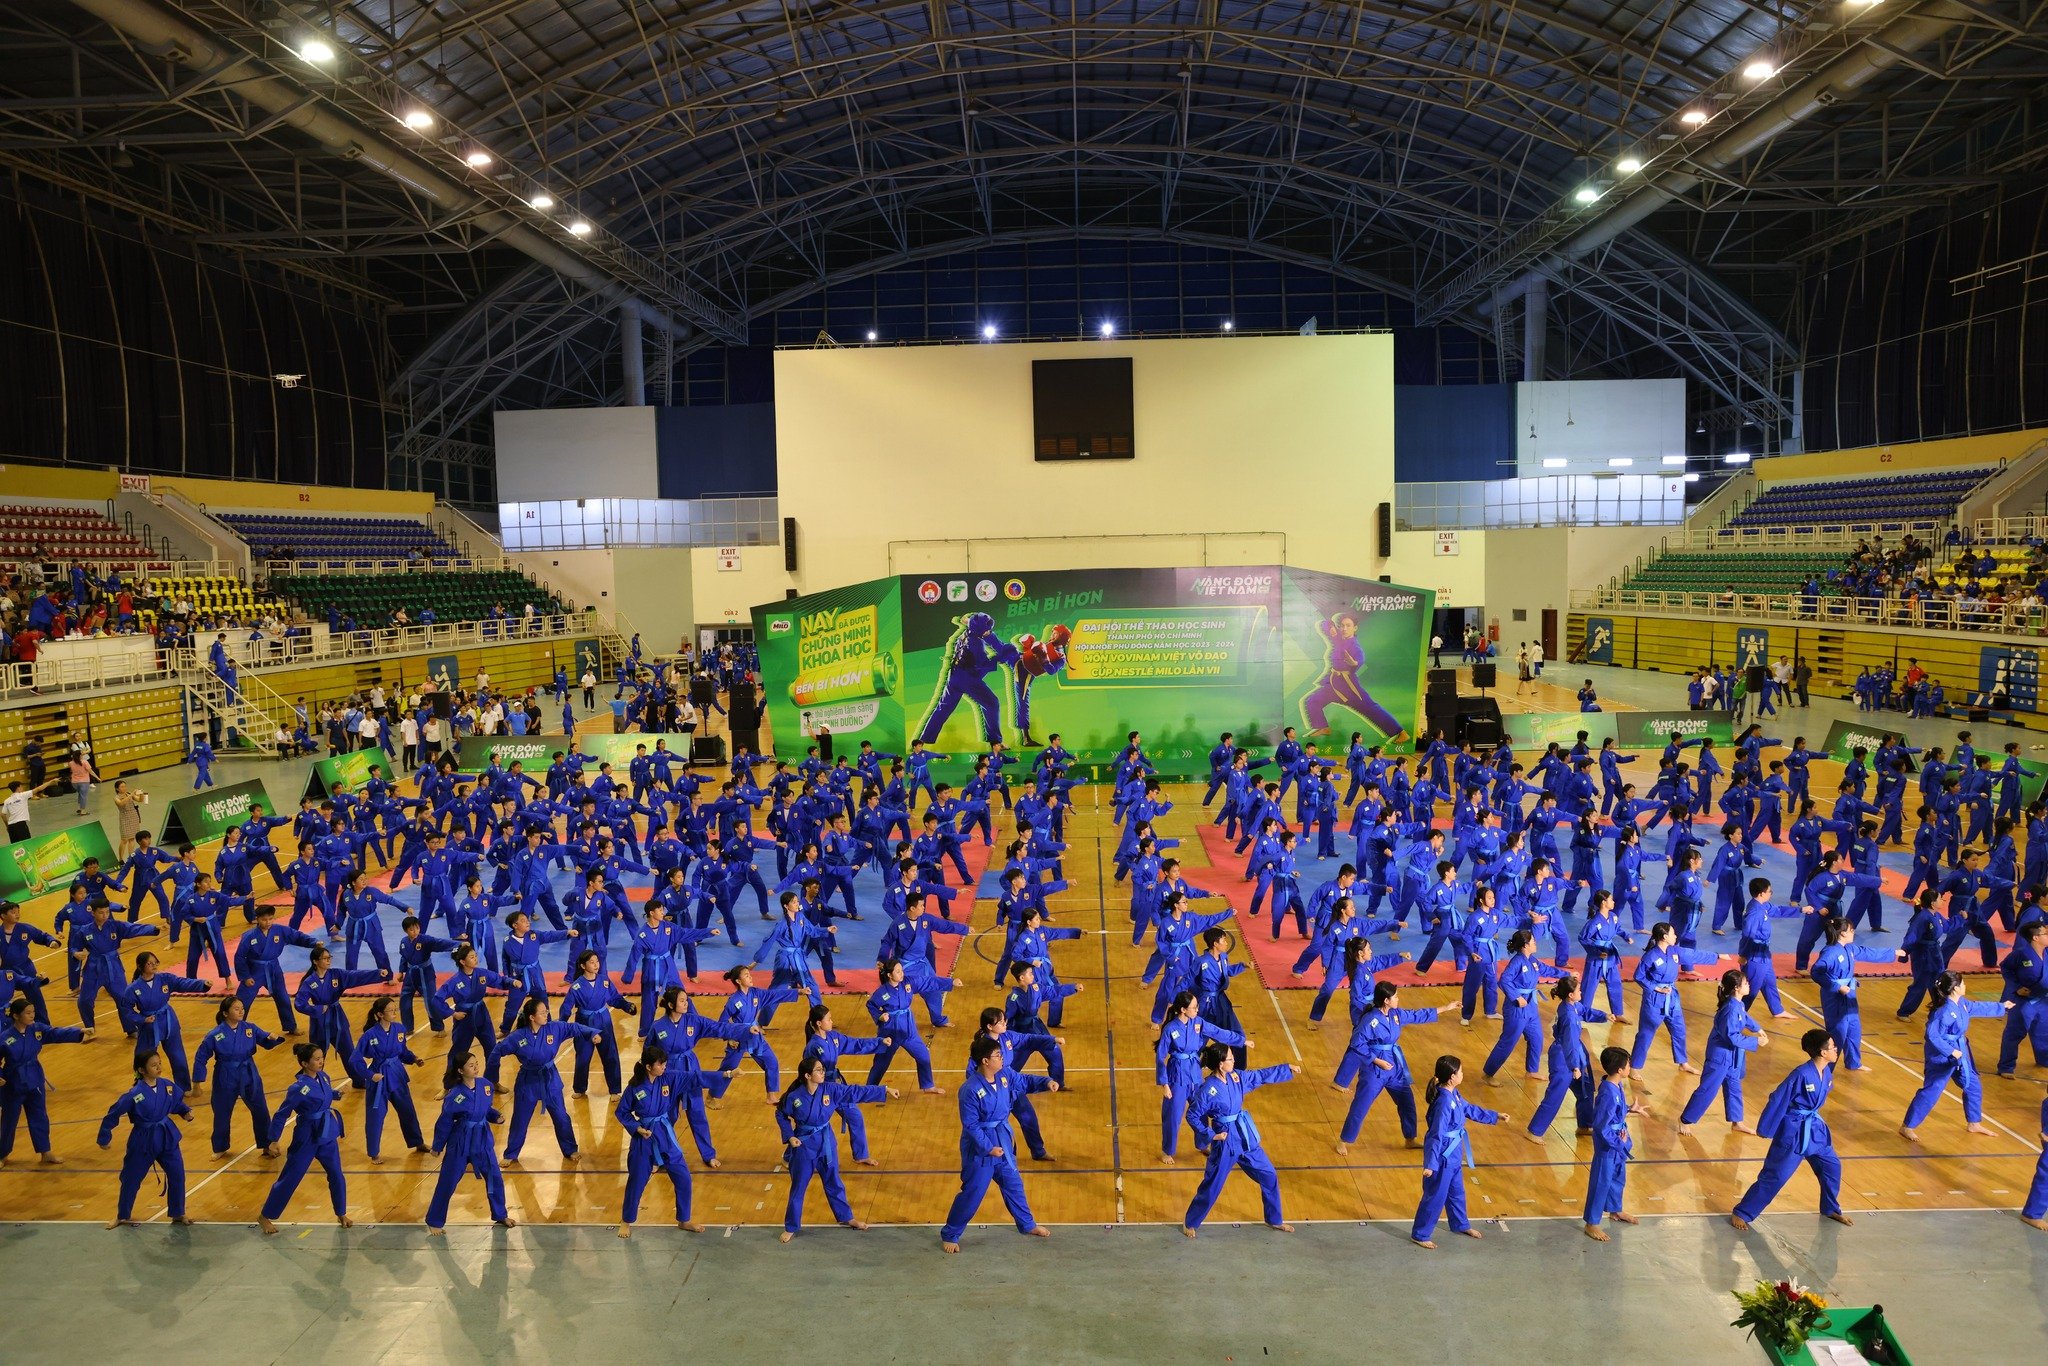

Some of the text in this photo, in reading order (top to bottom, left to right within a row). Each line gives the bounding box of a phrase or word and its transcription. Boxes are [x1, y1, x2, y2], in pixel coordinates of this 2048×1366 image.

[1880, 454, 1892, 463] C2
[122, 477, 148, 490] EXIT
[299, 493, 310, 502] B2
[1438, 532, 1454, 540] EXIT
[721, 548, 736, 556] EXIT
[1234, 575, 1272, 587] ĐỘNG
[1227, 585, 1257, 595] NAM
[1006, 589, 1104, 617] BỀN BỈ HƠN
[1385, 594, 1417, 604] ĐỘNG
[1380, 603, 1404, 611] NAM
[800, 607, 841, 638] NAY
[849, 614, 870, 627] ĐƯỢC
[1082, 623, 1101, 634] ĐẠI
[1103, 622, 1122, 634] HỘI
[1145, 622, 1176, 630] THAO
[1177, 621, 1200, 632] HỌC
[1200, 621, 1226, 630] SINH
[801, 624, 871, 654] CHỨNG MINH
[1075, 643, 1089, 653] HỘI
[1173, 641, 1190, 651] HỌC
[1216, 640, 1235, 648] 2024
[802, 639, 872, 671] KHOA HỌC
[1083, 652, 1109, 663] MÔN
[1110, 653, 1161, 663] VOVINAM
[1162, 650, 1187, 664] VIỆT
[1204, 651, 1228, 662] ĐẠO
[1091, 662, 1221, 677] CÚP NESTLÉ MILO LẦN VII
[510, 751, 534, 759] NAM
[1006, 774, 1013, 783] 2
[1090, 765, 1099, 780] 1
[226, 803, 246, 817] NAM
